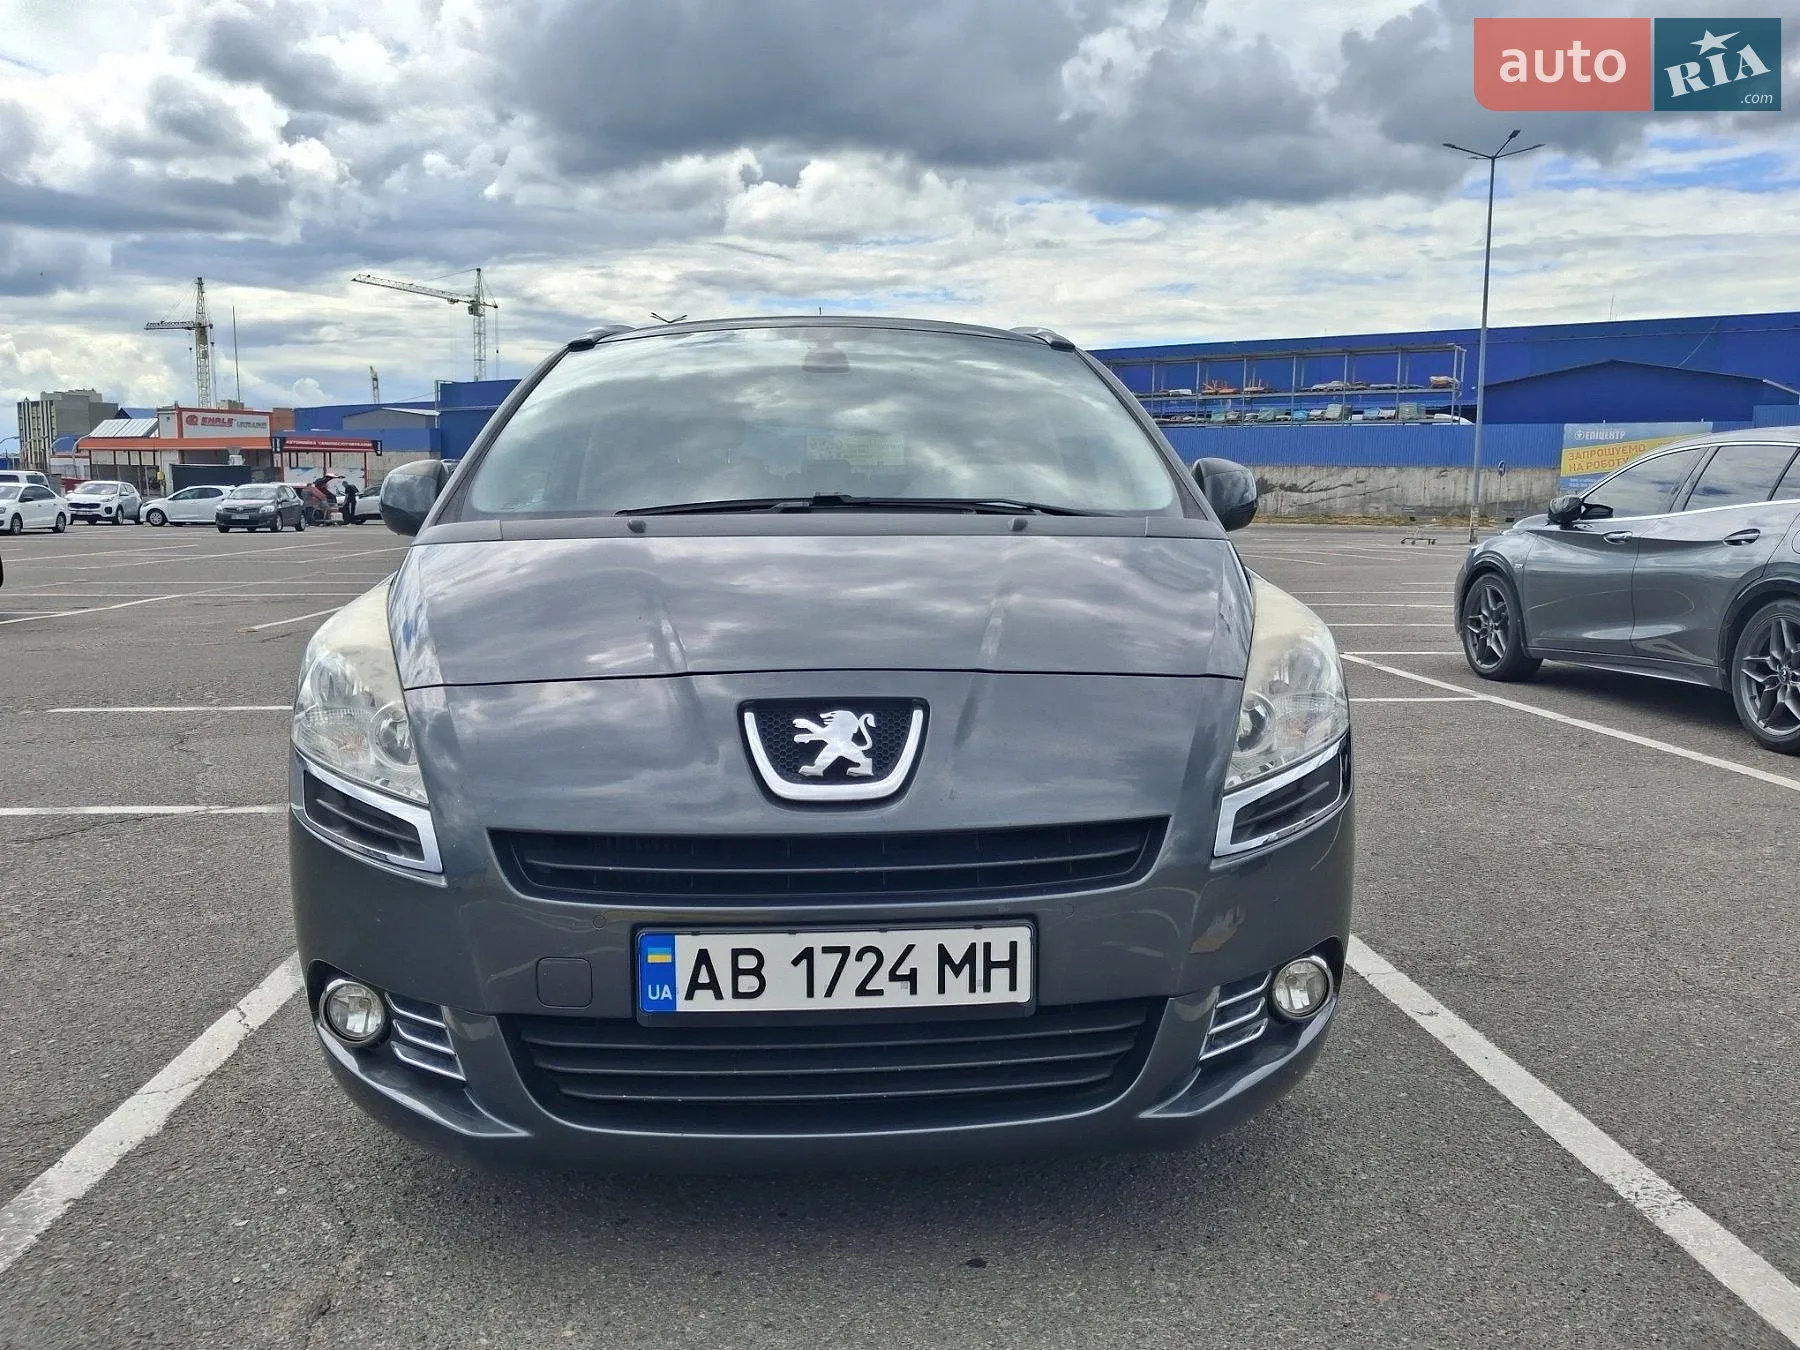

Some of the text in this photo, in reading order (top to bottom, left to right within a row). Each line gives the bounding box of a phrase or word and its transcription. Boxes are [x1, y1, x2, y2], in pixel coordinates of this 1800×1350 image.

[201, 416, 233, 425] EHRLE
[1584, 430, 1625, 440] ЕПІЦЕНТР
[1568, 443, 1646, 461] ЗАПРОШУЄМО
[1569, 457, 1629, 472] НА РОБОТУ
[684, 940, 1018, 1000] AB 1724 MH
[647, 984, 673, 1001] UA
